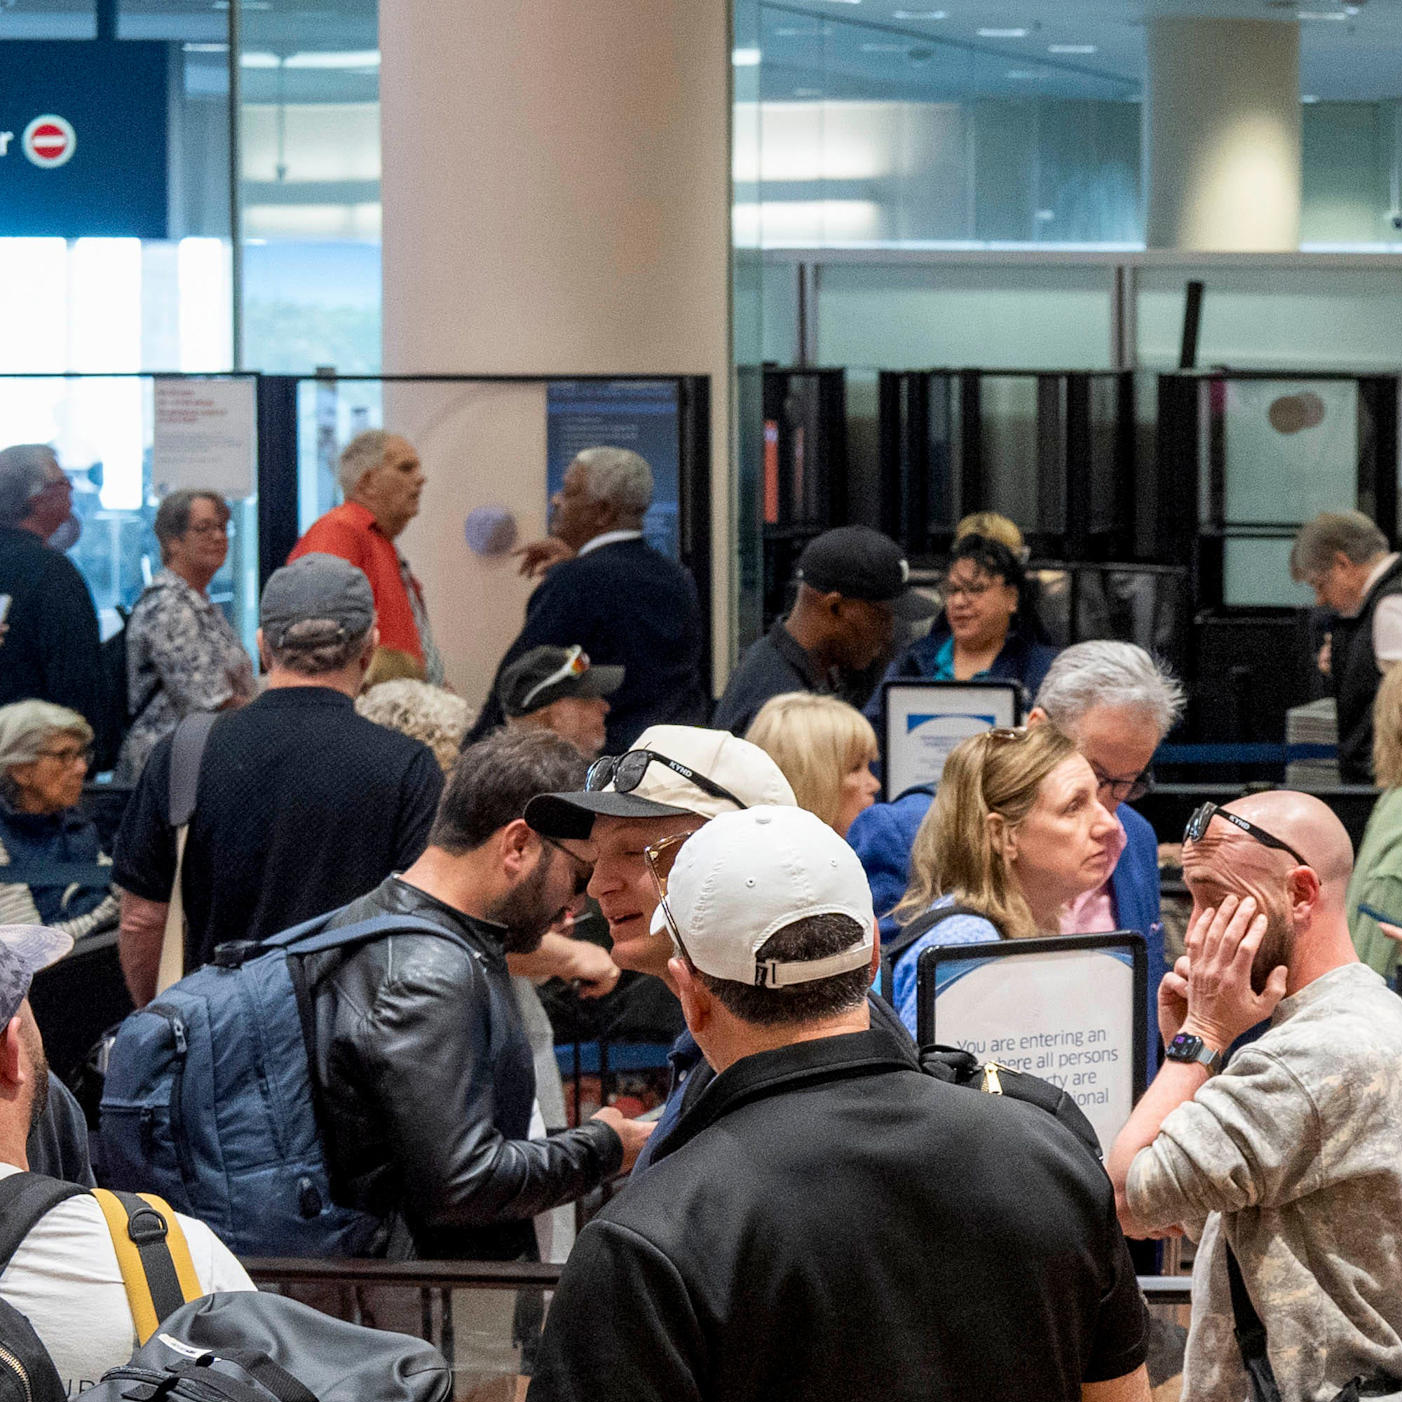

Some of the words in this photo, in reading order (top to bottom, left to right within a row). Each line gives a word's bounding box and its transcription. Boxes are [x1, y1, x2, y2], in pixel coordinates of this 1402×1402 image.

[957, 1039, 986, 1054] You
[990, 1037, 1016, 1051] are
[1019, 1029, 1083, 1049] entering
[1087, 1028, 1106, 1043] an
[997, 1056, 1032, 1071] here
[1036, 1053, 1054, 1068] all
[1058, 1048, 1119, 1068] persons
[1042, 1074, 1068, 1088] rty
[1072, 1071, 1097, 1086] are
